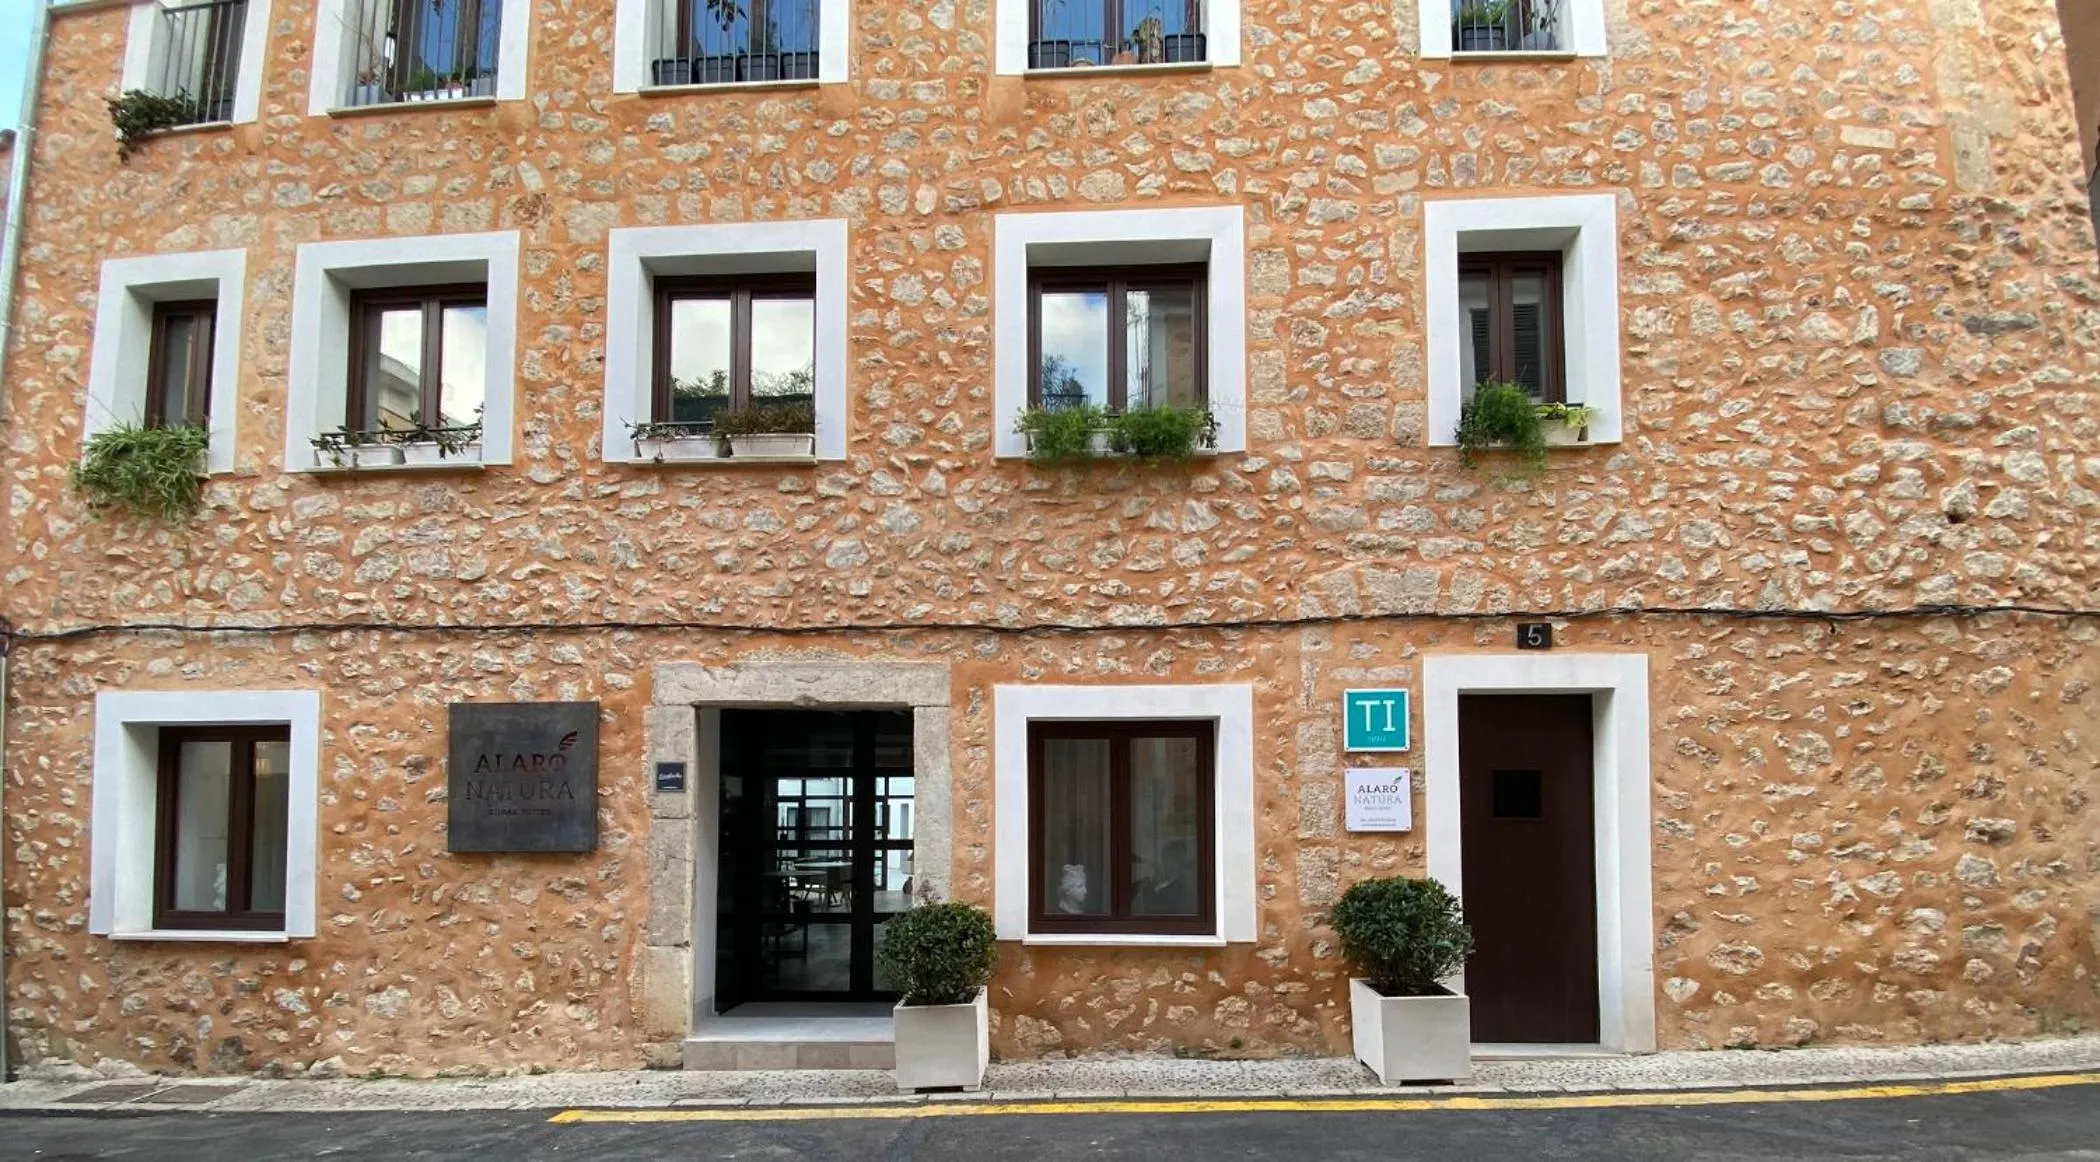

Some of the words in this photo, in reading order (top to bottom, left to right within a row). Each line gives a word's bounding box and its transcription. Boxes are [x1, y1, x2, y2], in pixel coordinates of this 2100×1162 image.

[1528, 624, 1542, 646] 5
[1355, 700, 1396, 732] TI
[465, 781, 575, 801] NATURA
[1354, 795, 1402, 805] NATURA
